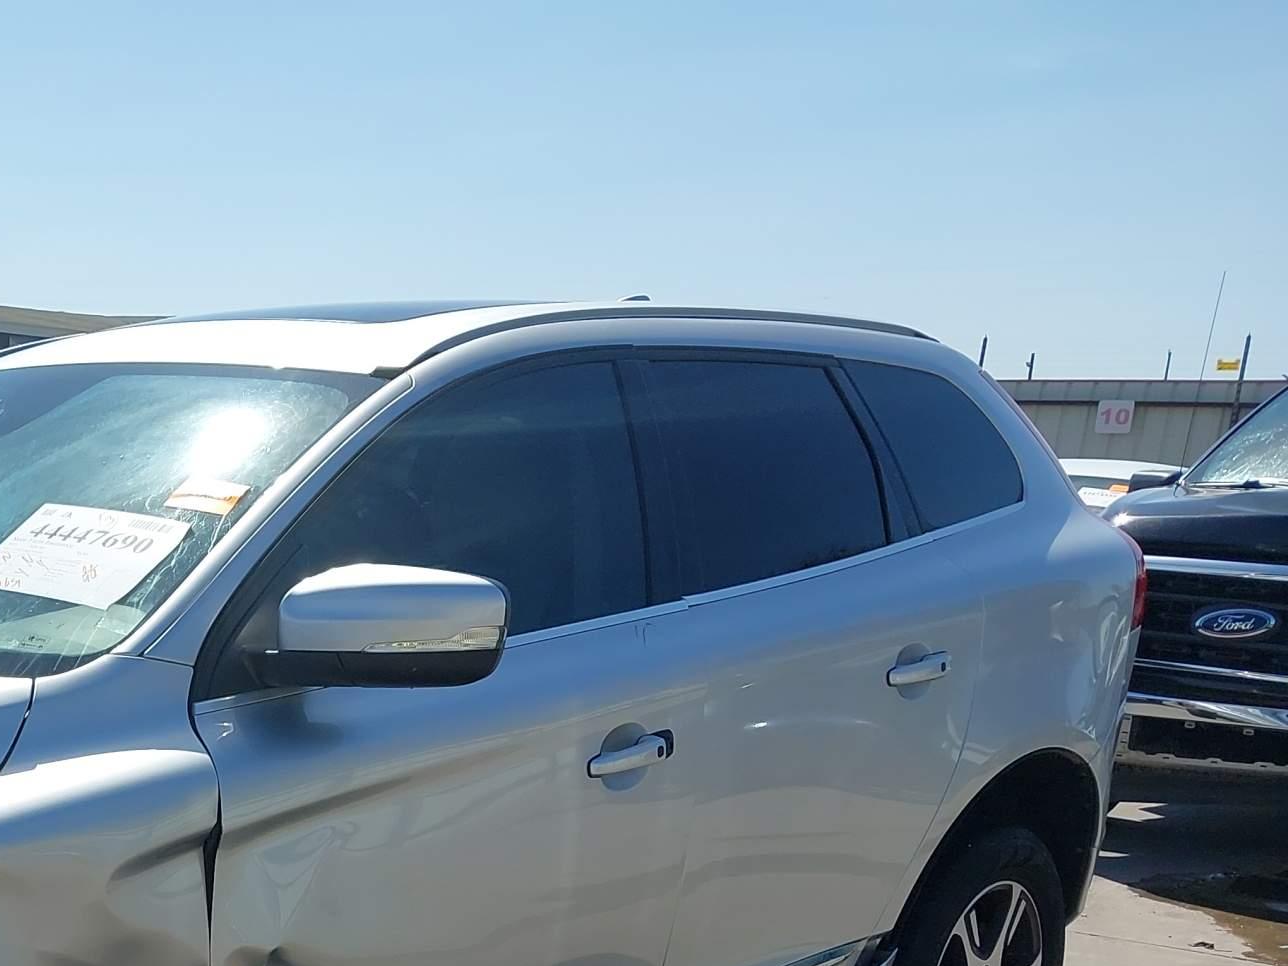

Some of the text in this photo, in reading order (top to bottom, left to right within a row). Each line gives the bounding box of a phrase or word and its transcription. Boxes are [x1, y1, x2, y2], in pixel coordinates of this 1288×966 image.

[1100, 407, 1130, 425] 10
[29, 522, 154, 554] 44447690
[1213, 614, 1255, 632] Ford
